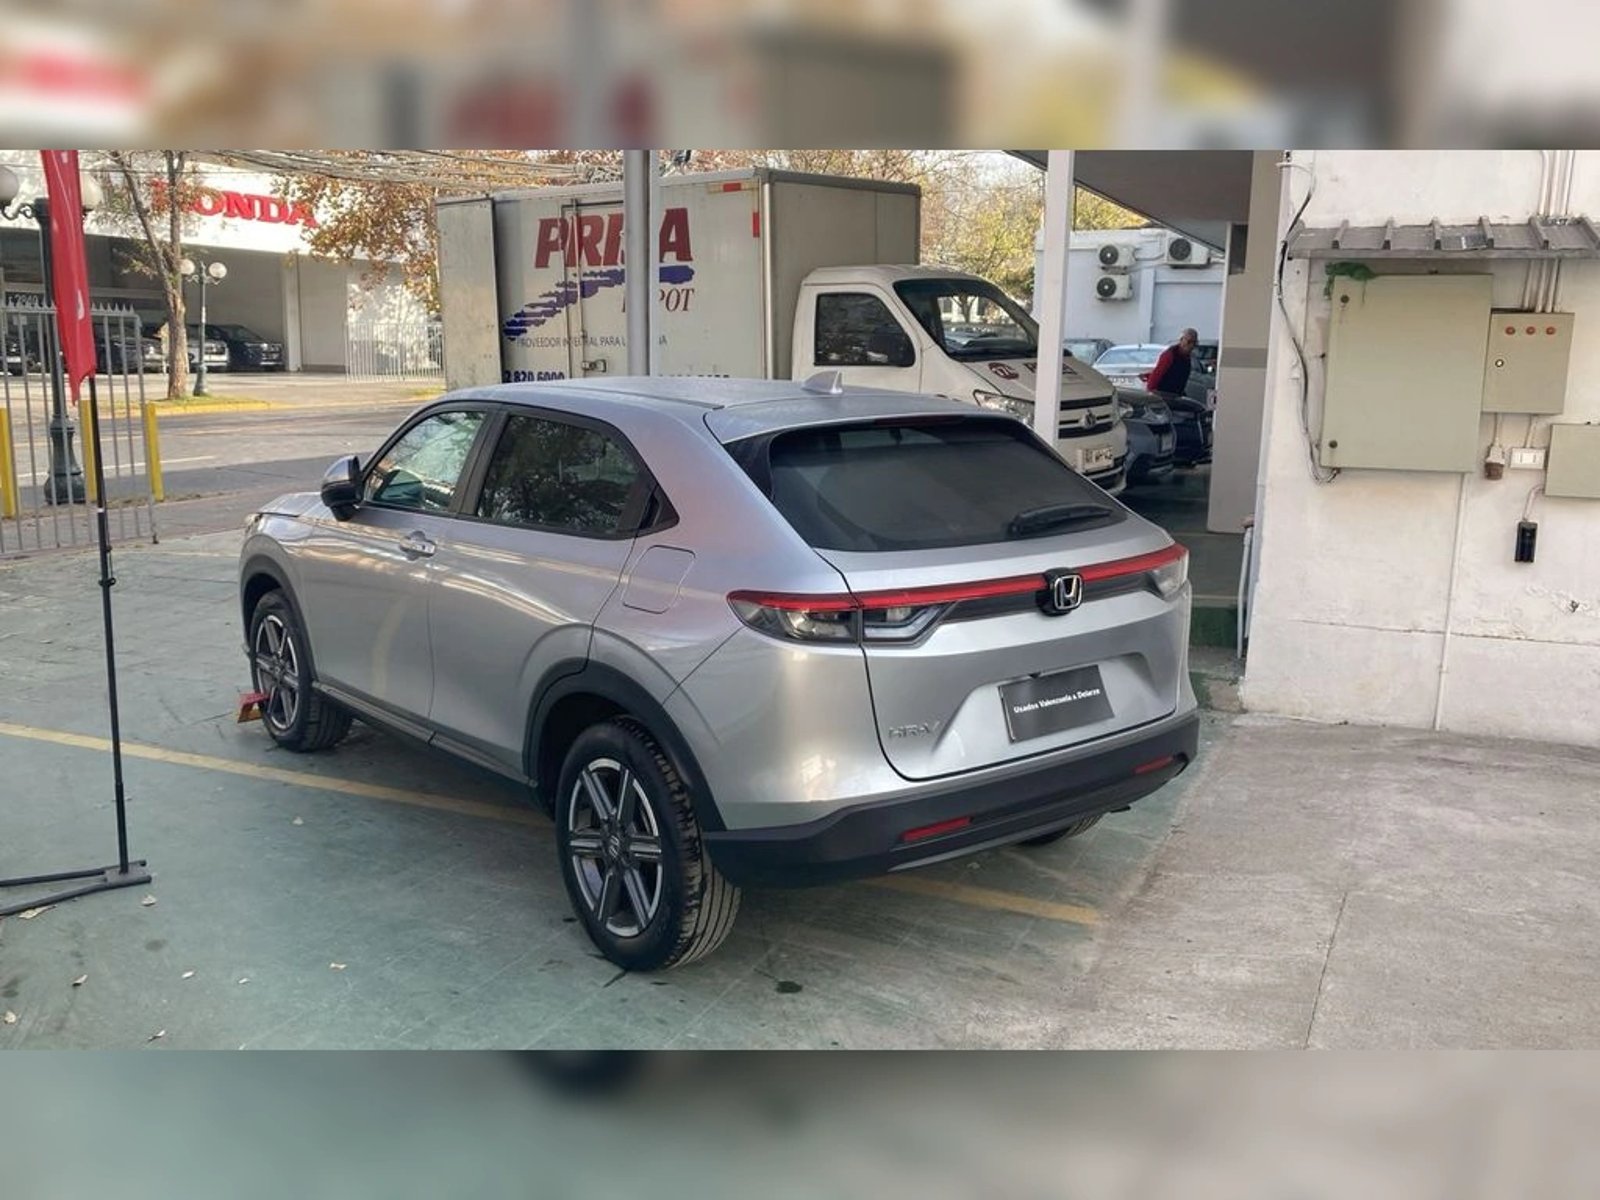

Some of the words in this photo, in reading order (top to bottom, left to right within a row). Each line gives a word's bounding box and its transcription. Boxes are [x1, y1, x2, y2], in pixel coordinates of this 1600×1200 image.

[153, 179, 319, 228] ONDA
[535, 207, 693, 269] PRIA
[600, 335, 619, 347] PARA
